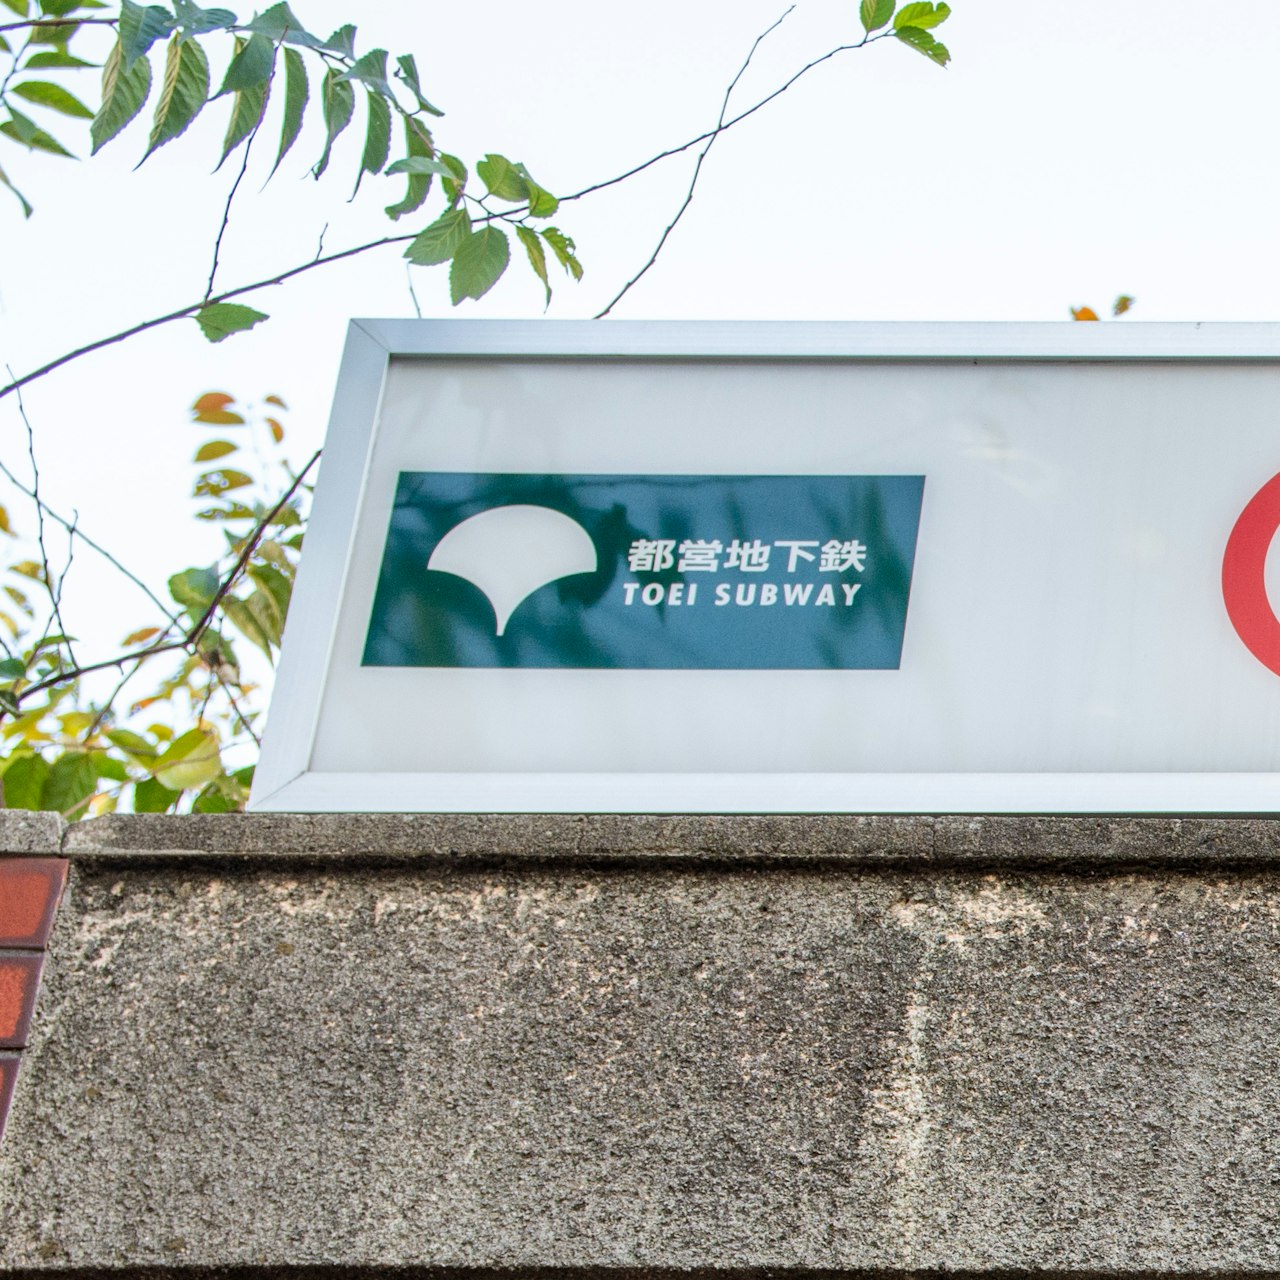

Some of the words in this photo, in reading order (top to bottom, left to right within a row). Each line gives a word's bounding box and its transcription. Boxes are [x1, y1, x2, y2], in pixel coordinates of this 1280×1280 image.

[627, 539, 867, 573] 都営地下鉄
[622, 582, 698, 607] TOEI
[714, 582, 862, 607] SUBWAY
